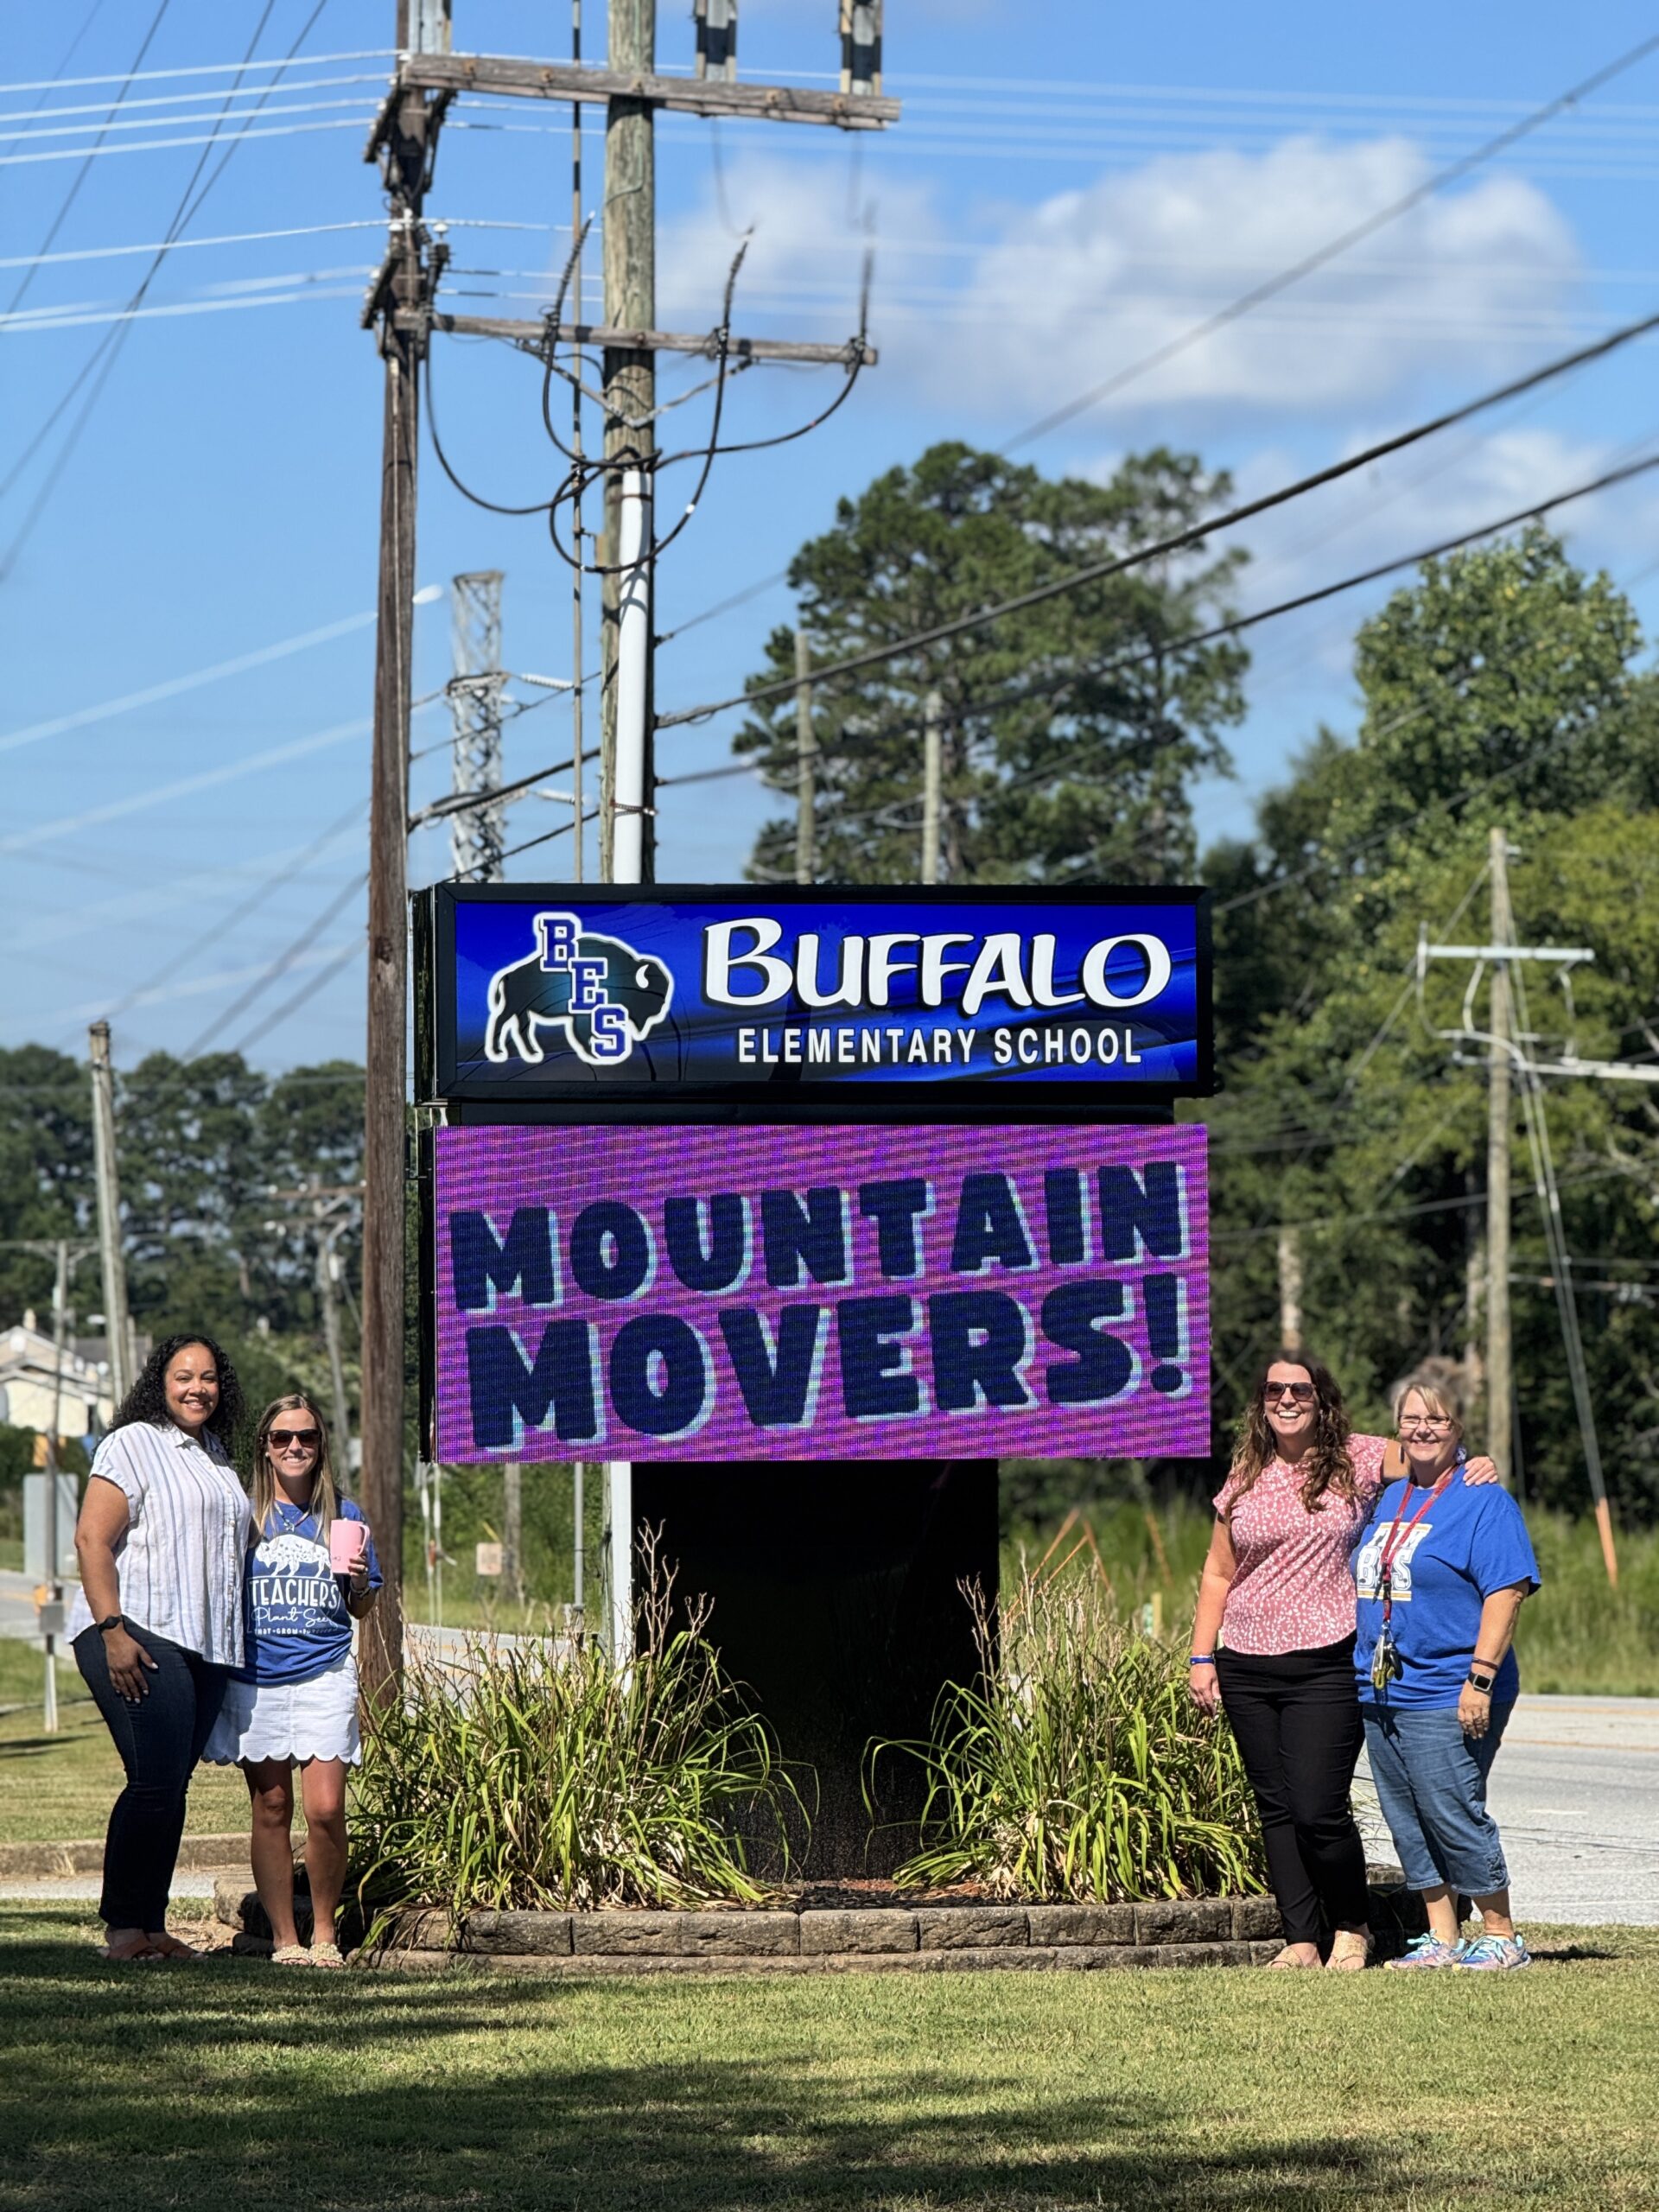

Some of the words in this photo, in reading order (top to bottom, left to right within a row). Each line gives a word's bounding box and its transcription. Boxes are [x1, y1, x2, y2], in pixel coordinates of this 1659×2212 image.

[704, 918, 1172, 1014] BUFFALO
[738, 1027, 974, 1064] ELEMENTARY
[995, 1028, 1141, 1064] SCHOOL
[450, 1160, 1190, 1314] MOUNTAIN
[465, 1274, 1192, 1452] MOVERS!
[1357, 1546, 1414, 1590] BS
[250, 1579, 339, 1608] TEACHERS
[251, 1606, 302, 1626] Plant
